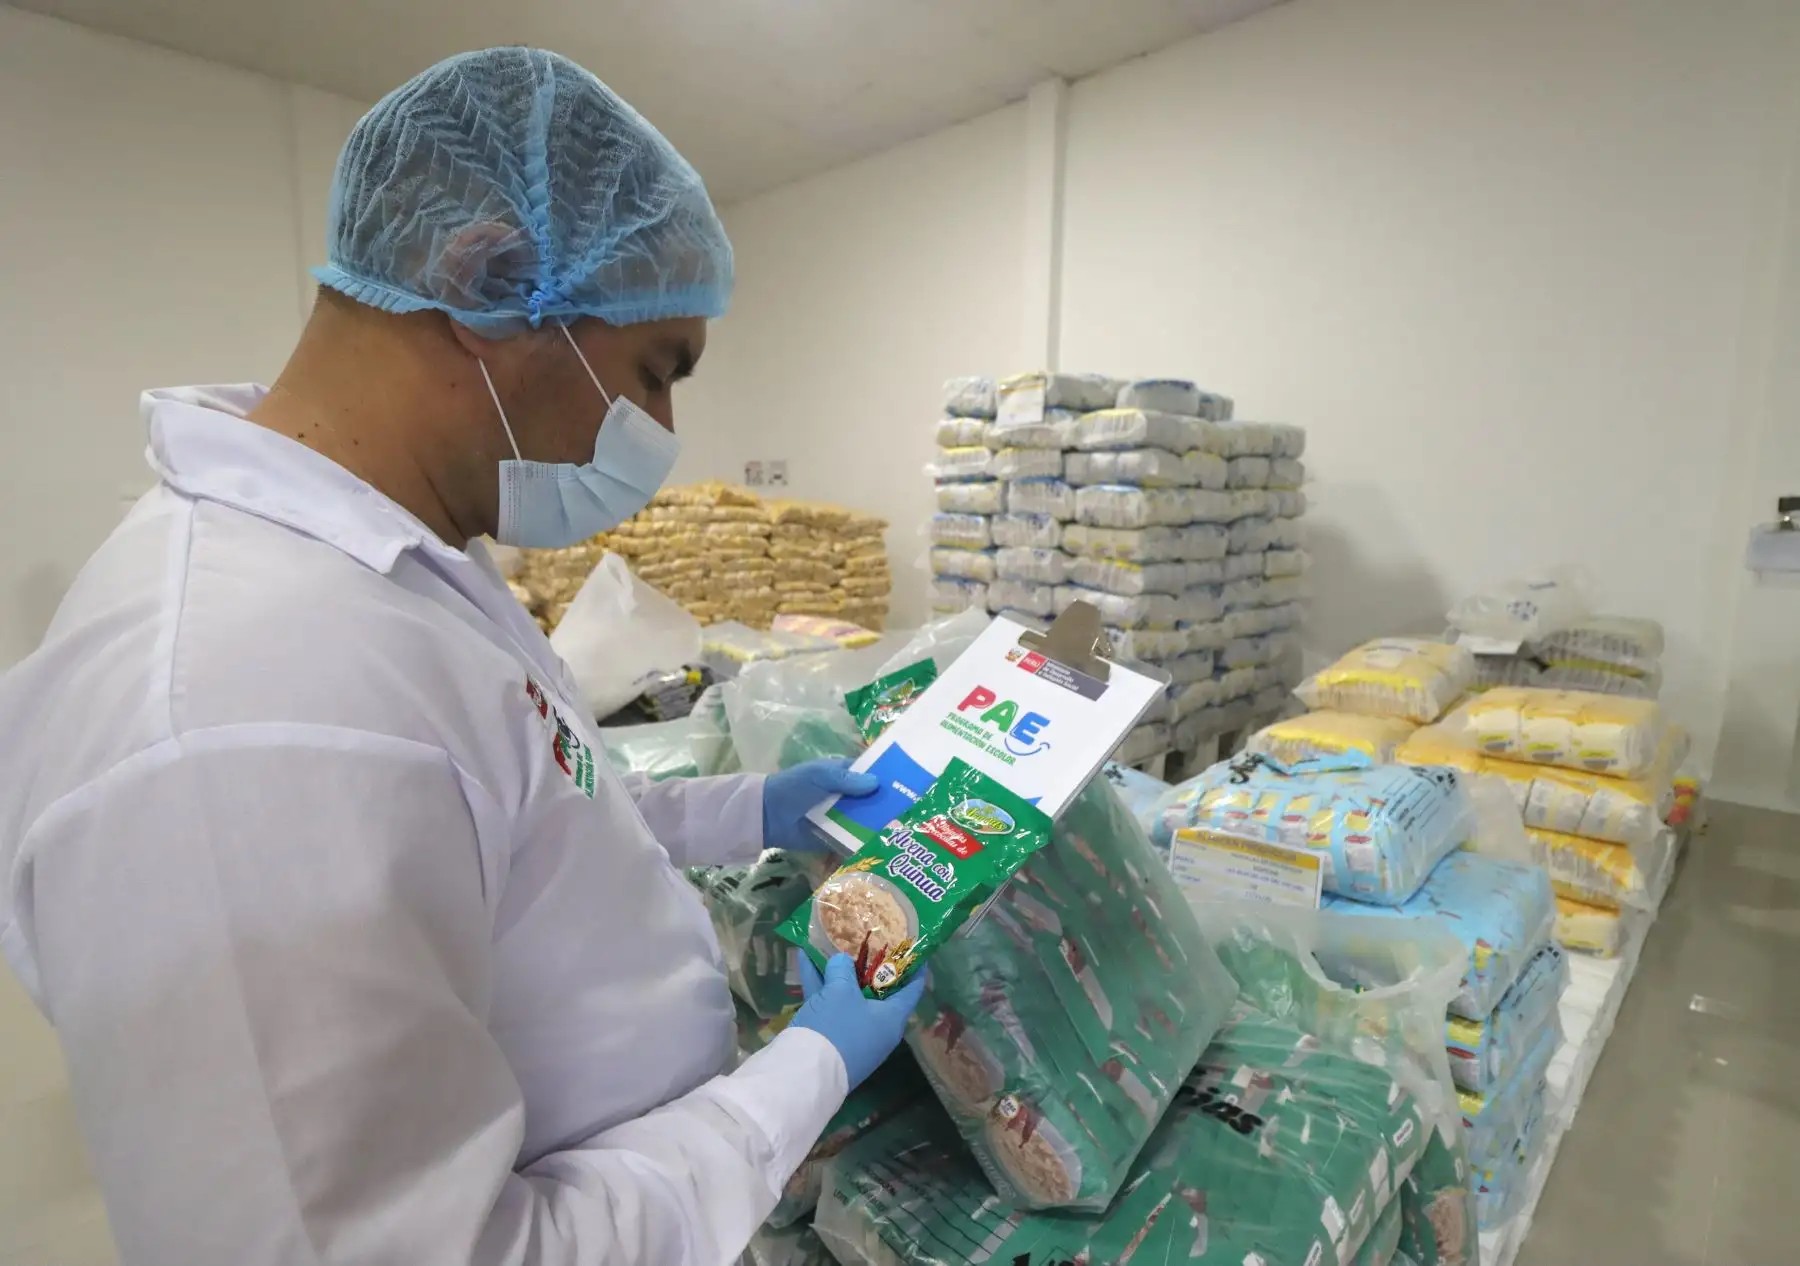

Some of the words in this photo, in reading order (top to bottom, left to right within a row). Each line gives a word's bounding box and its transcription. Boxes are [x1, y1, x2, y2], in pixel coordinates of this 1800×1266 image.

[957, 684, 1051, 746] PAE
[884, 852, 947, 902] Quinua
[885, 829, 938, 868] Avena
[931, 862, 955, 883] con
